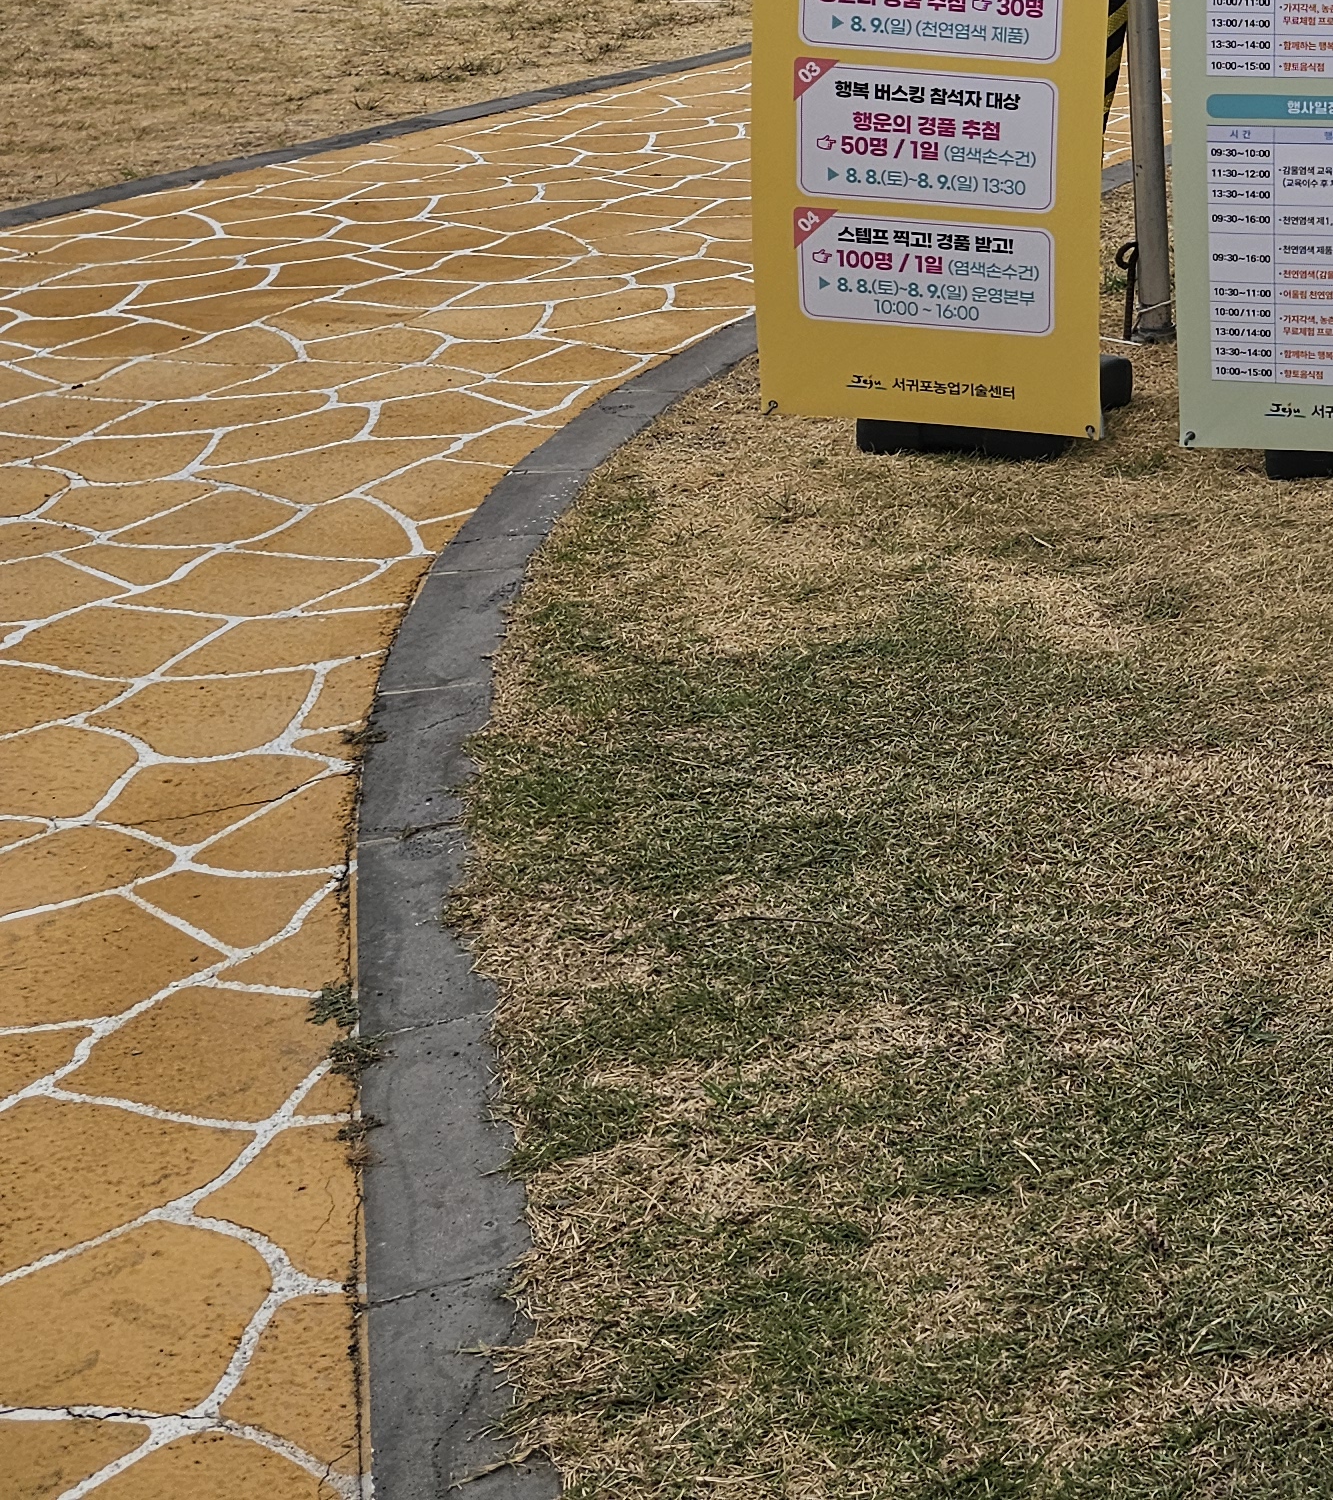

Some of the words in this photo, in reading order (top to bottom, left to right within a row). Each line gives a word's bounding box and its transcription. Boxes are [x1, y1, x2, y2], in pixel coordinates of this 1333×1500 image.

[798, 62, 821, 83] 03
[835, 80, 870, 99] 행복
[874, 83, 925, 104] 버스킹
[931, 88, 982, 108] 참석자
[986, 92, 1020, 110] 대상
[797, 211, 820, 232] 04
[893, 229, 932, 248] 찍고!
[936, 232, 970, 251] 경품
[975, 236, 1014, 254] 받고!
[1213, 288, 1271, 299] 10:30~11:00
[1216, 367, 1272, 377] 10:00~15:00
[893, 378, 1015, 399] 서귀포농업기술센터
